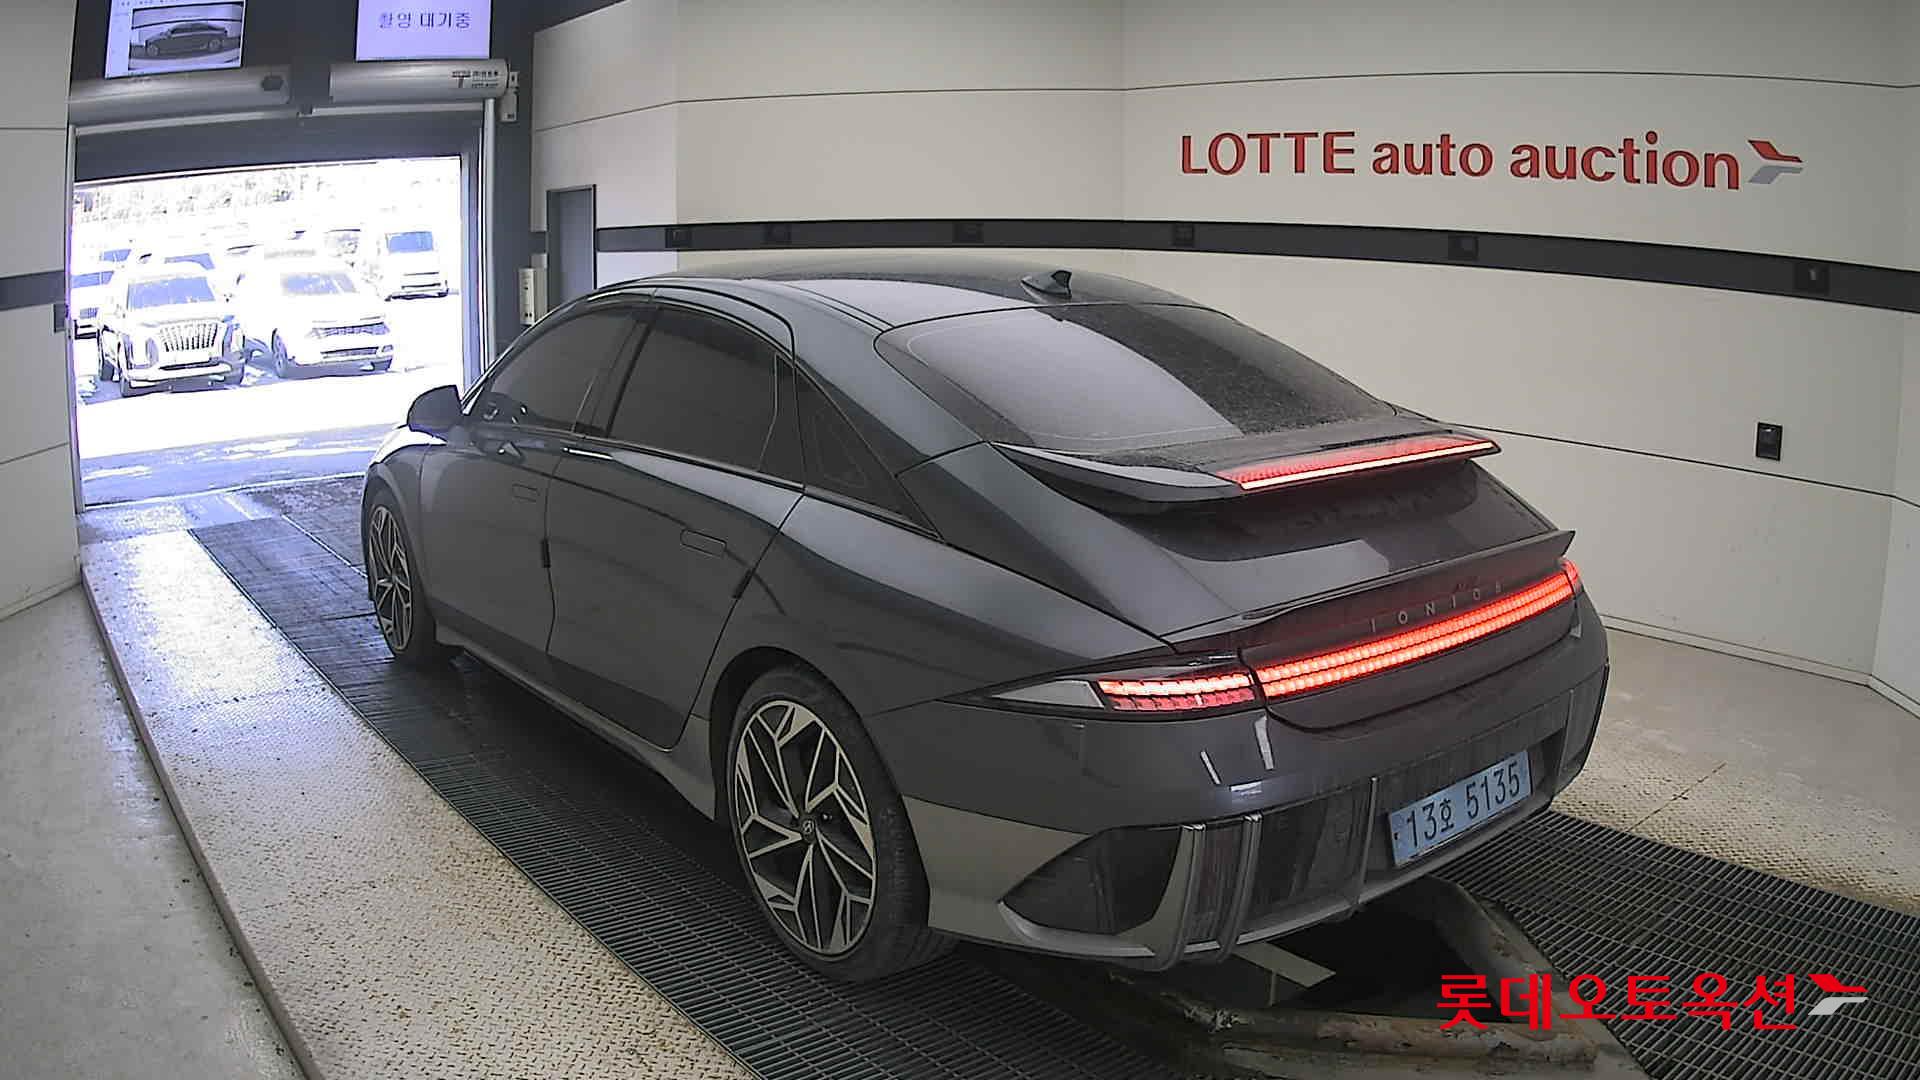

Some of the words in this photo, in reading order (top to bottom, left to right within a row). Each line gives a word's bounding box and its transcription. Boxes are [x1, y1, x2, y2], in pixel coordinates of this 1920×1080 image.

[420, 12, 471, 29] 대기중
[1181, 131, 1355, 176] LOTTE
[1372, 133, 1494, 177] auto
[1509, 130, 1740, 190] auction
[1406, 798, 1455, 849] 13호
[1465, 760, 1520, 821] 5135
